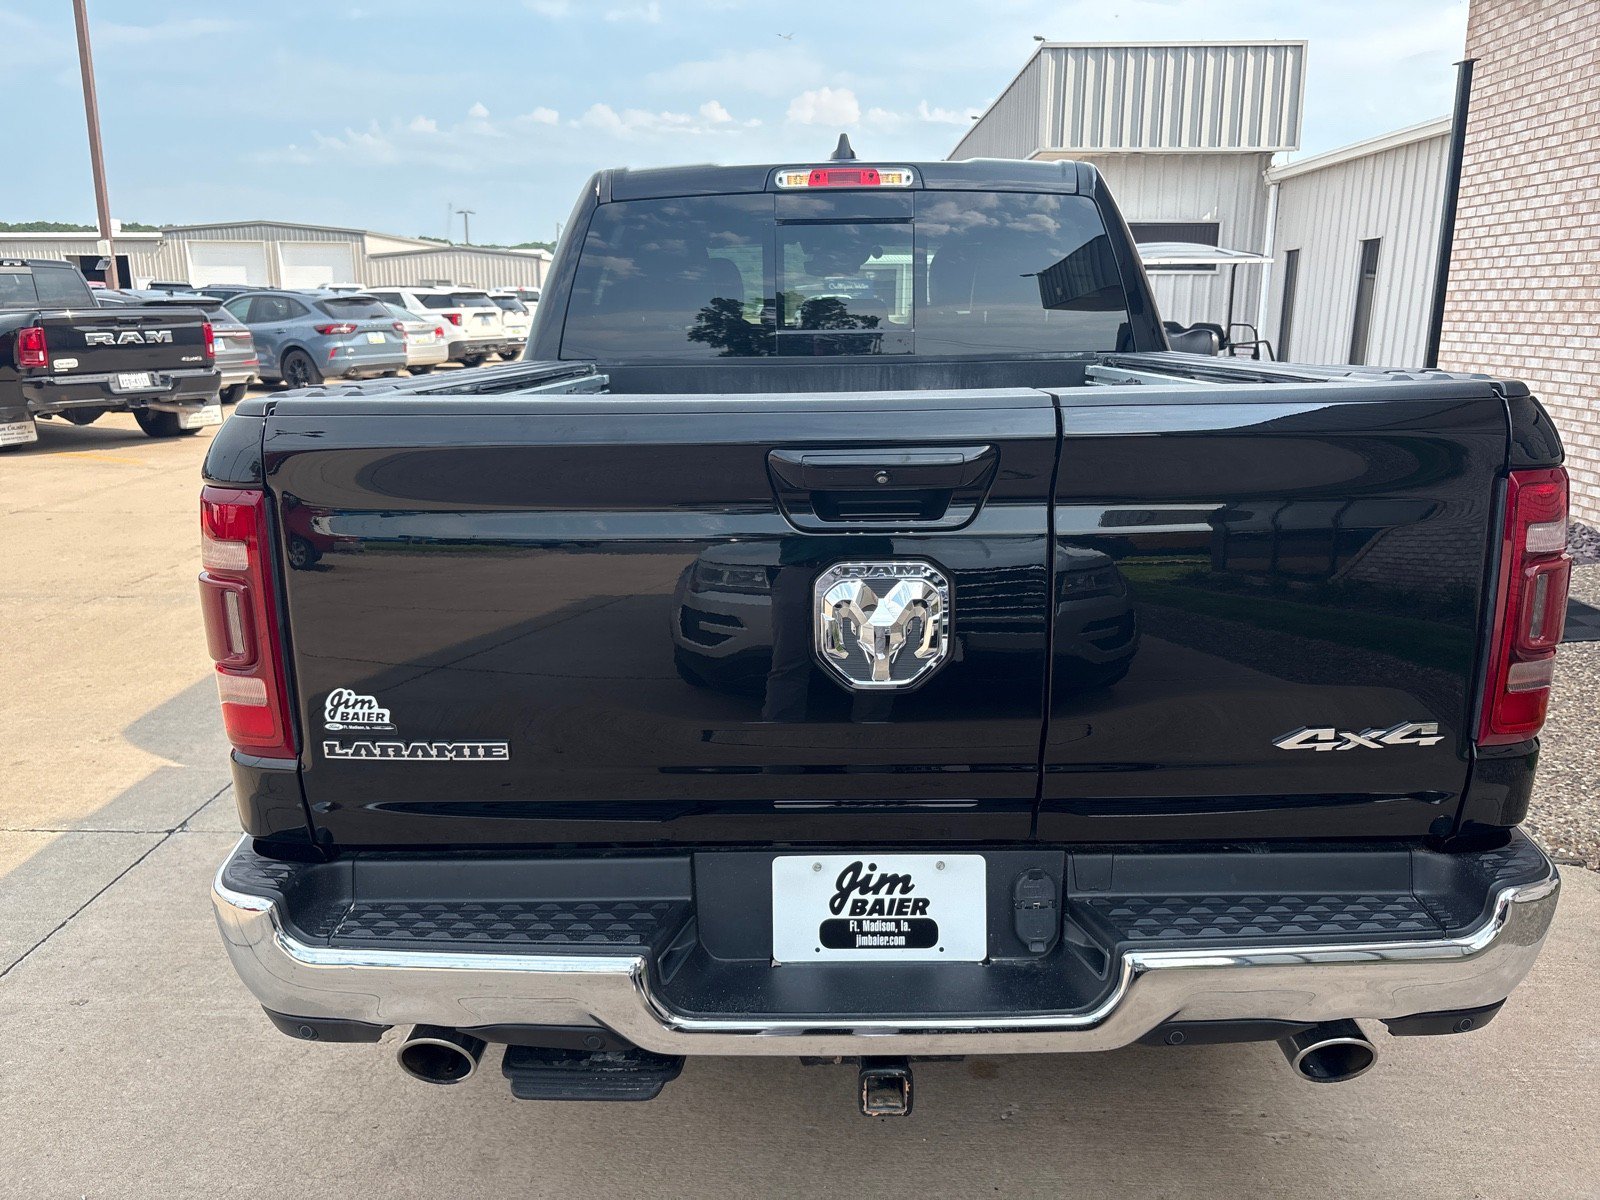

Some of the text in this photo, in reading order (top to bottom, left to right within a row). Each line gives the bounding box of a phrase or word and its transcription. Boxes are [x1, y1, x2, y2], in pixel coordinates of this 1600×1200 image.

[84, 330, 174, 346] RAM
[840, 564, 923, 578] RAM
[328, 689, 376, 721] Jim
[340, 711, 386, 722] BAIER
[322, 741, 510, 761] LARAMIE
[829, 860, 916, 916] Jim
[848, 897, 931, 917] BAIER
[849, 920, 911, 933] Ft. Madison, Ia.
[855, 934, 906, 948] jimbaier.com
